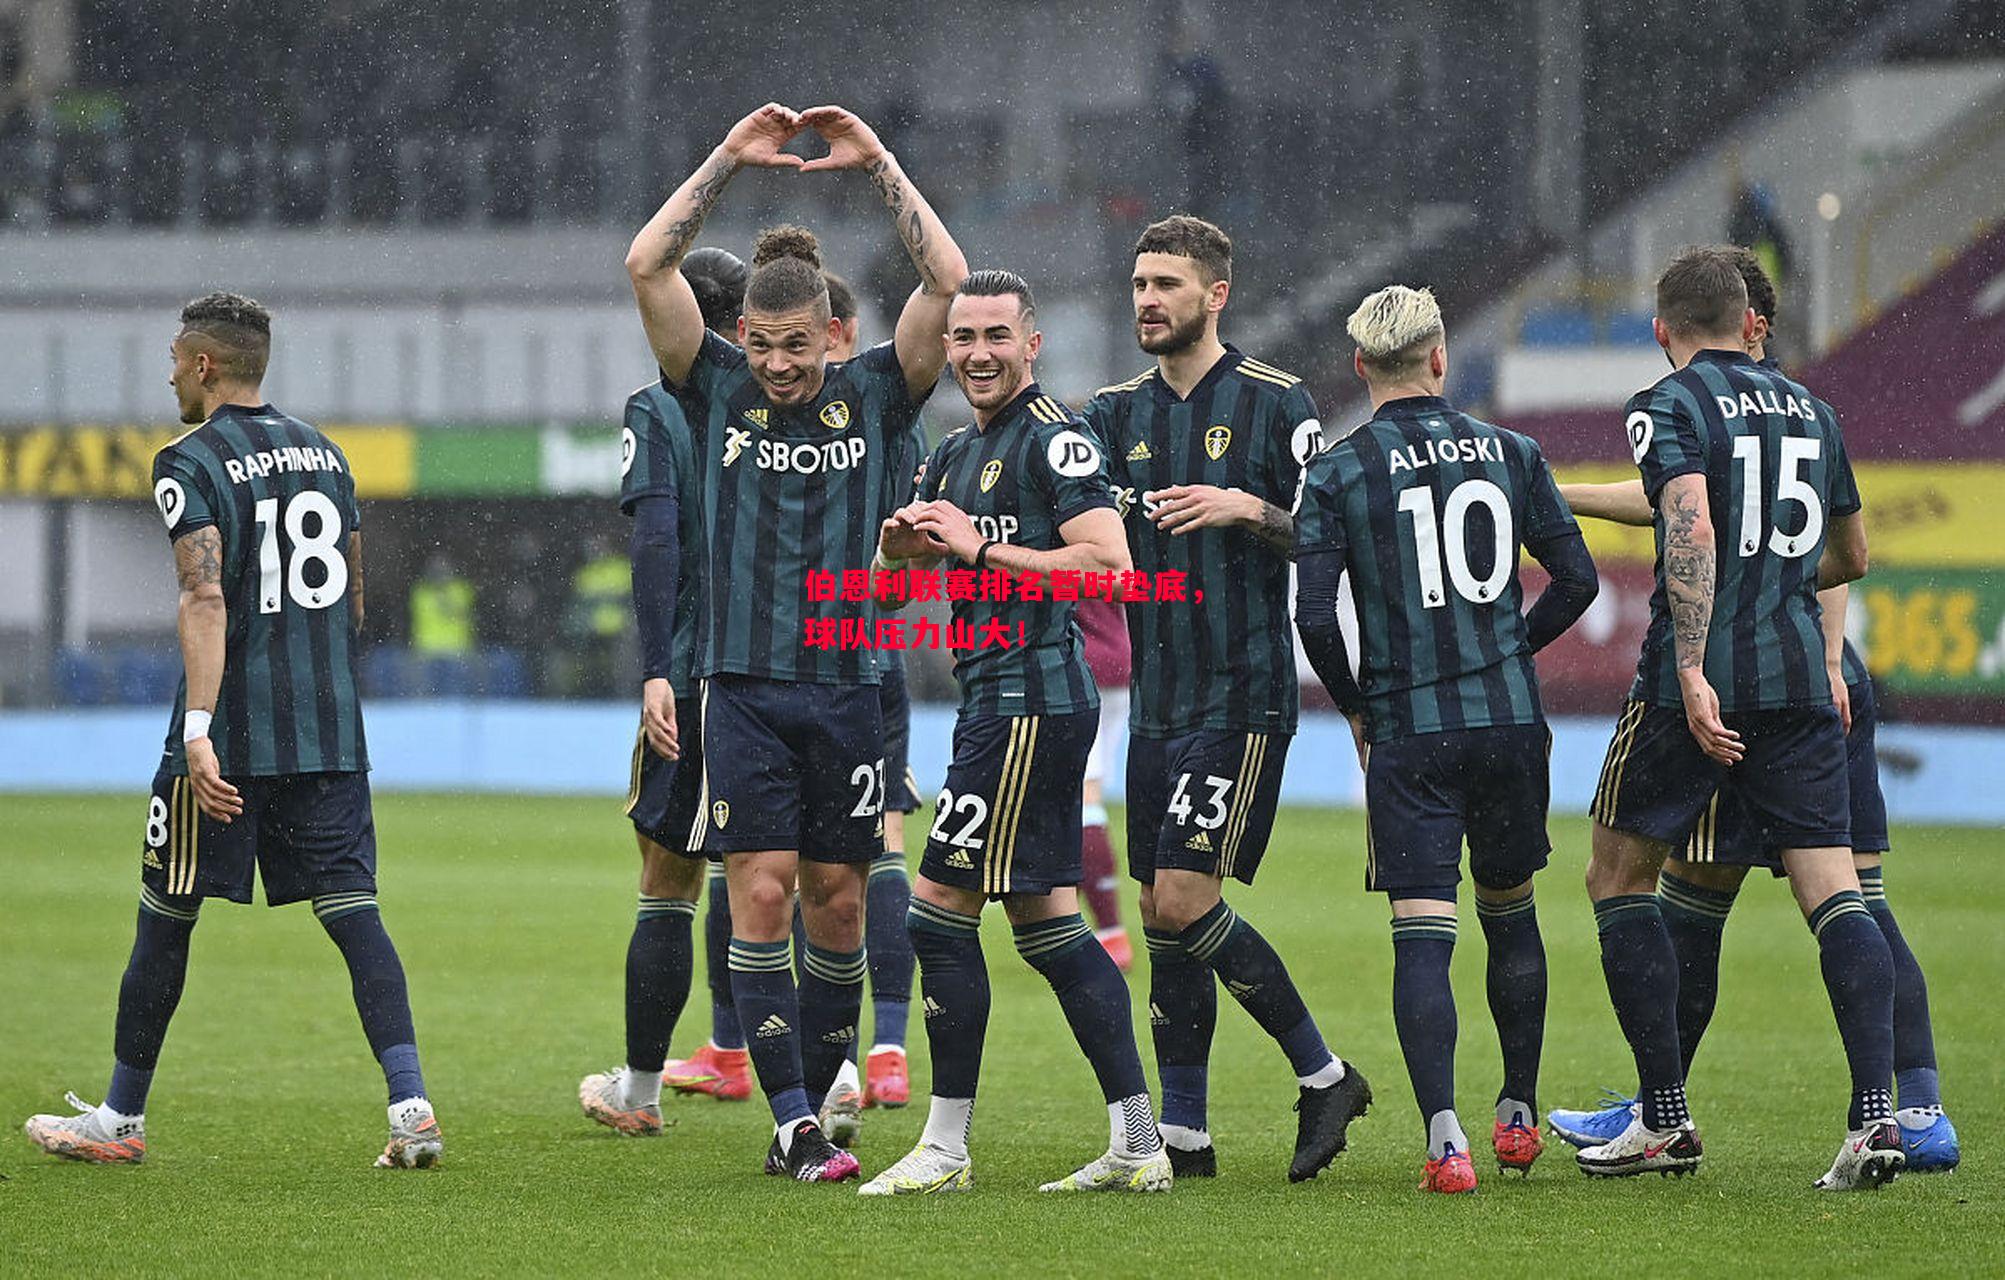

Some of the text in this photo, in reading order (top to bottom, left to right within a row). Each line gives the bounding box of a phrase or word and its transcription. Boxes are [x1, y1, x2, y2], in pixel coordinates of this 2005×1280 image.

[1716, 390, 1816, 422] DALLAS
[225, 447, 343, 484] RAPHINHA
[756, 437, 867, 474] SBOTOP
[1059, 442, 1092, 469] JD
[1389, 437, 1504, 475] ALIOSKI
[1732, 435, 1824, 558] 15
[255, 490, 348, 614] 18
[1398, 479, 1513, 608] 10
[930, 788, 988, 849] 22
[1167, 773, 1234, 829] 43
